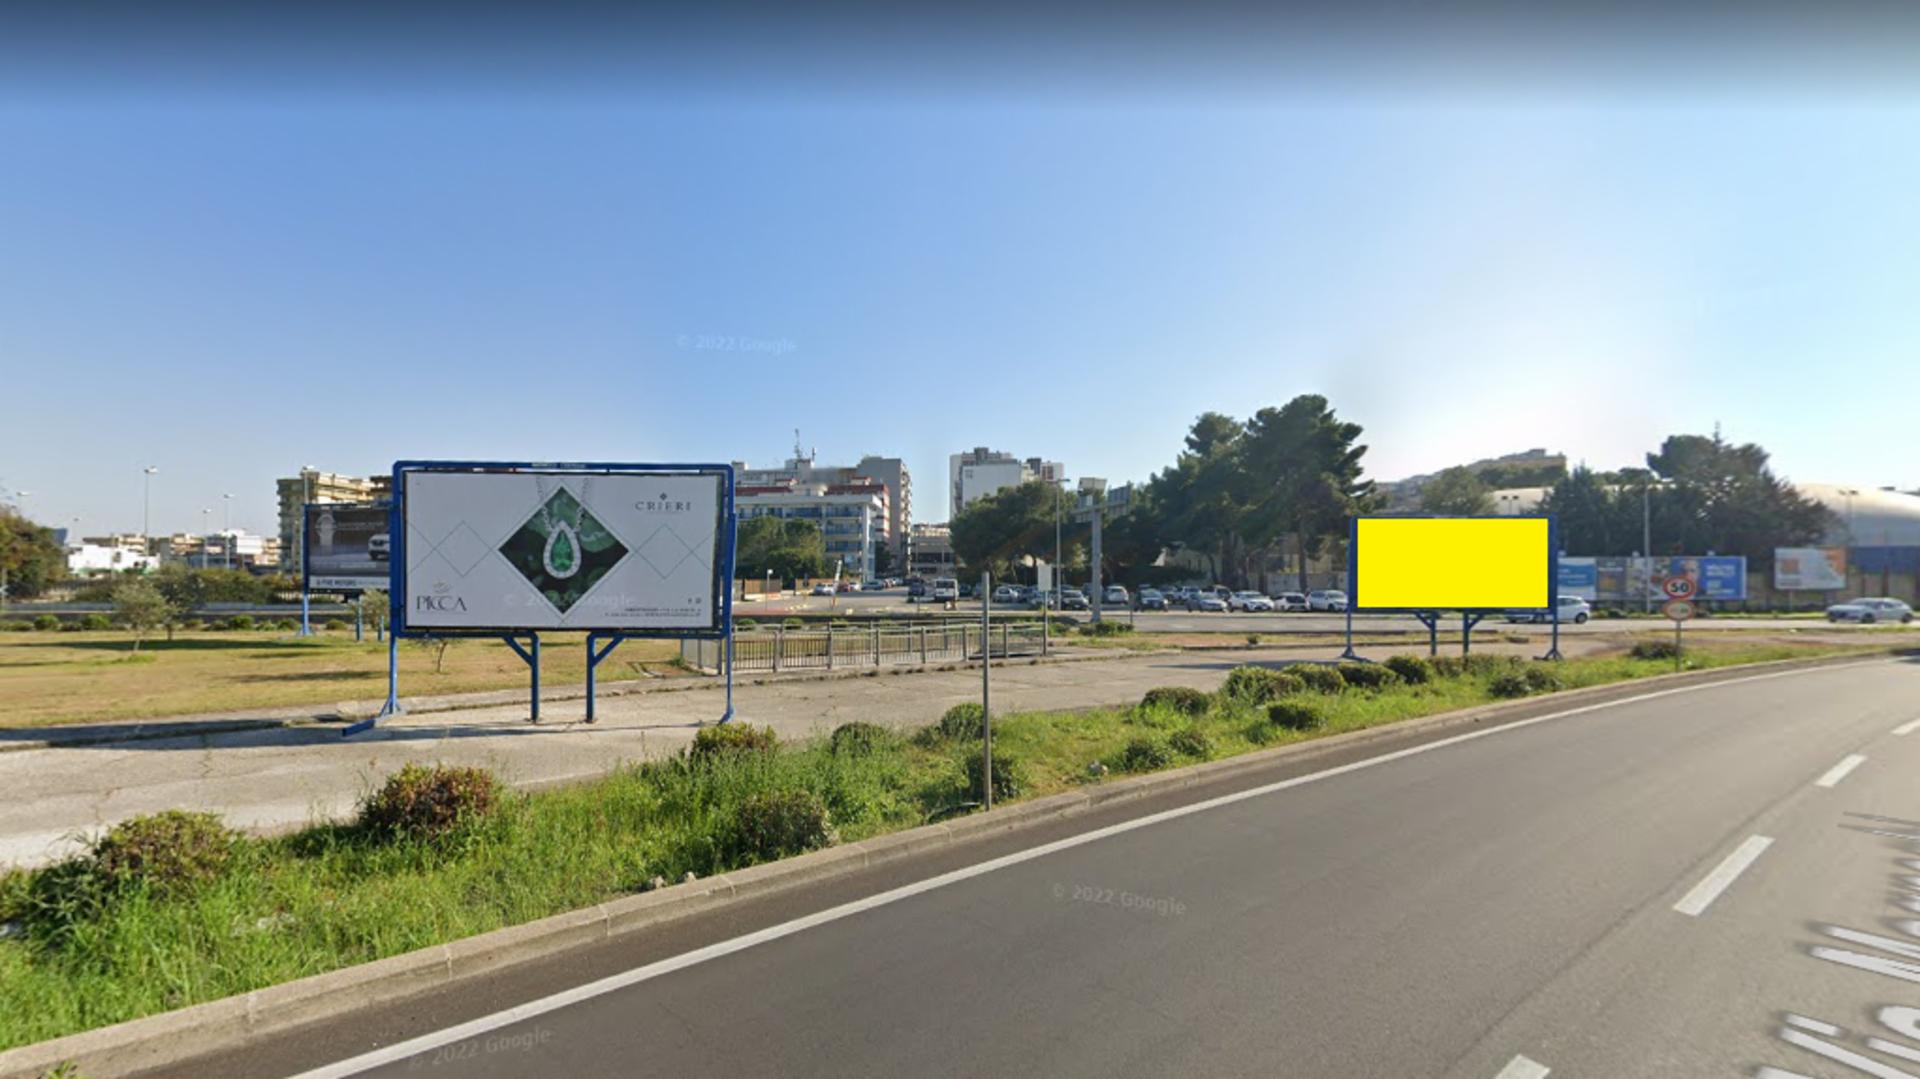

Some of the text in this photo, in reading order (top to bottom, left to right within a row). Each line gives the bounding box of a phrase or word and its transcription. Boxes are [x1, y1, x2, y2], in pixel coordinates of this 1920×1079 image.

[634, 500, 691, 511] CRIERI
[1670, 582, 1690, 593] 50
[416, 595, 468, 611] PICCA
